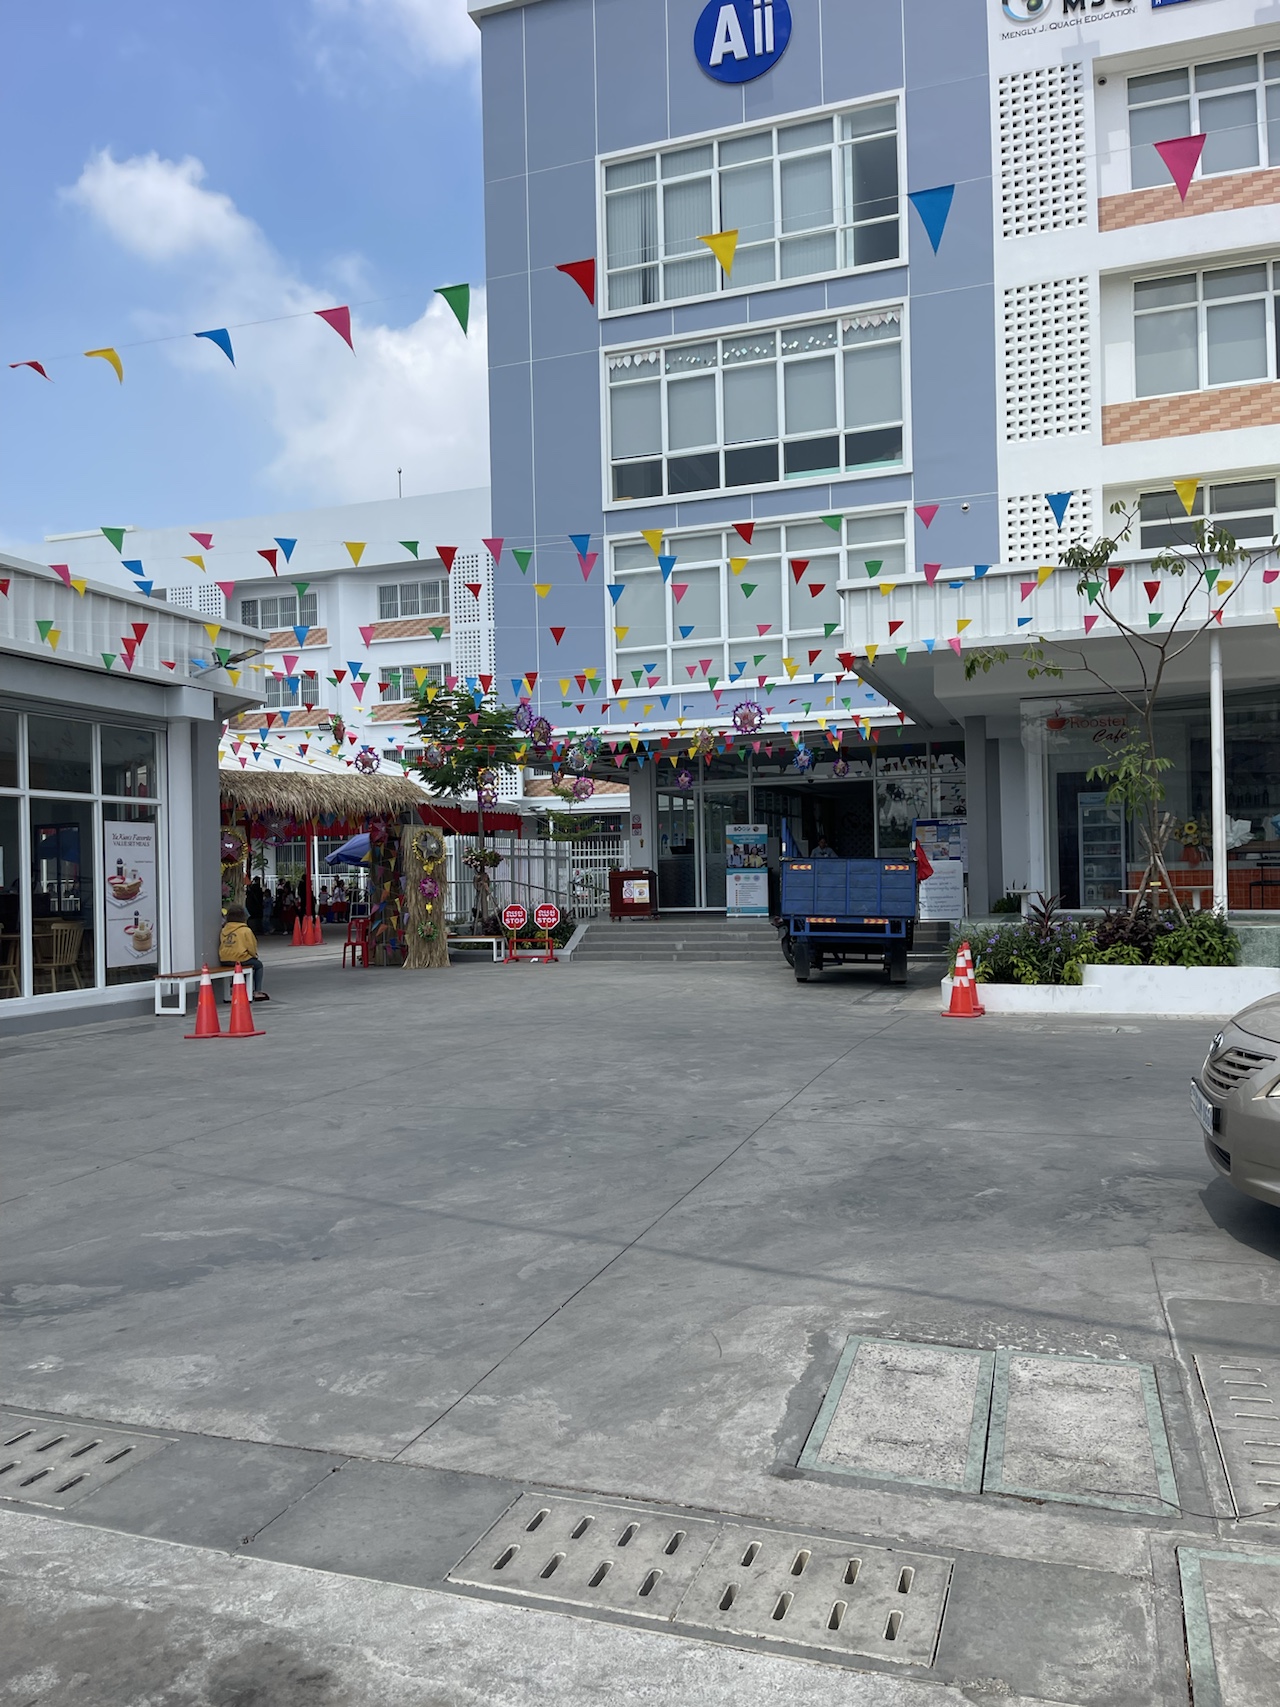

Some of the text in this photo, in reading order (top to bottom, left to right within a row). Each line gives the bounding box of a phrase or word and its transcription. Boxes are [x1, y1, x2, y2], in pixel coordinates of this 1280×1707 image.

[709, 0, 774, 66] Aii
[1001, 27, 1037, 40] MENGLY
[1049, 18, 1082, 30] QUACH
[1084, 7, 1136, 24] EDUCATION
[1069, 716, 1127, 728] Rooster
[1093, 728, 1127, 743] Cafe
